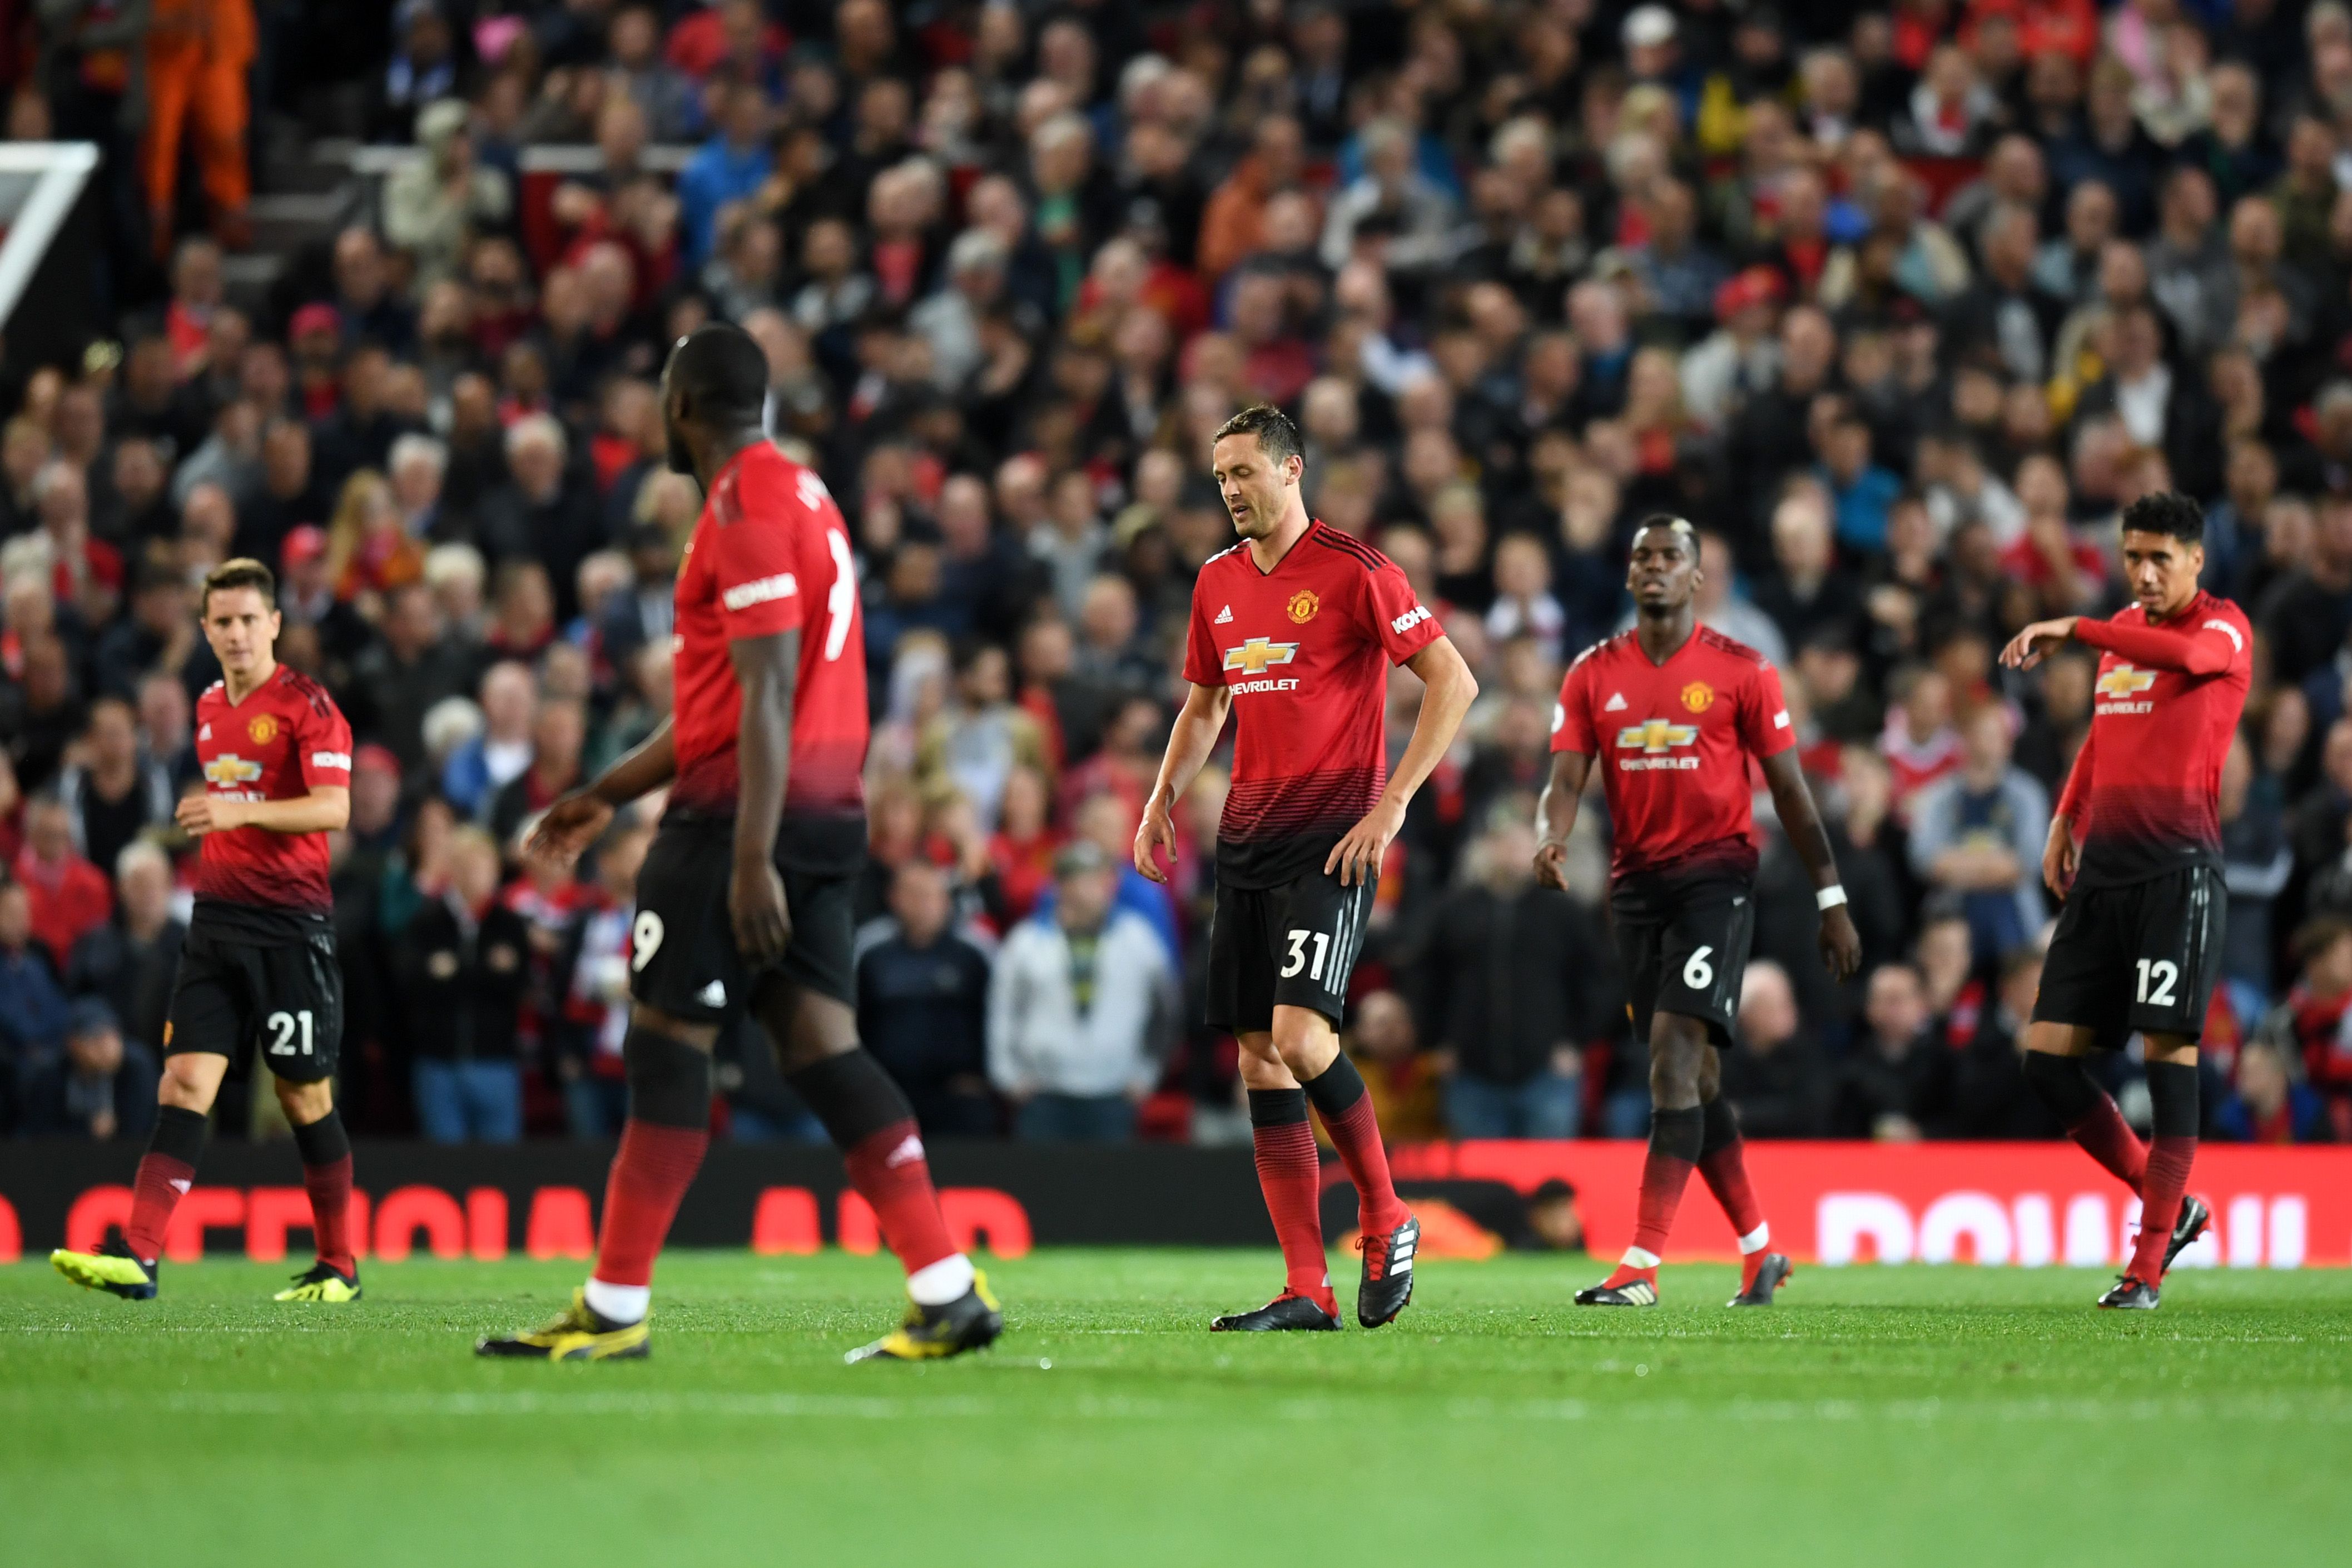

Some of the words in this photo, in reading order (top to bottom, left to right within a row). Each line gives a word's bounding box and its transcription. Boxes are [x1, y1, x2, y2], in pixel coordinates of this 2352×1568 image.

[1228, 678, 1300, 696] HEVROLET
[632, 910, 664, 973] 9
[1281, 929, 1330, 981] 31
[1683, 945, 1714, 990] 6
[2136, 957, 2179, 1007] 12
[267, 1010, 313, 1056] 21
